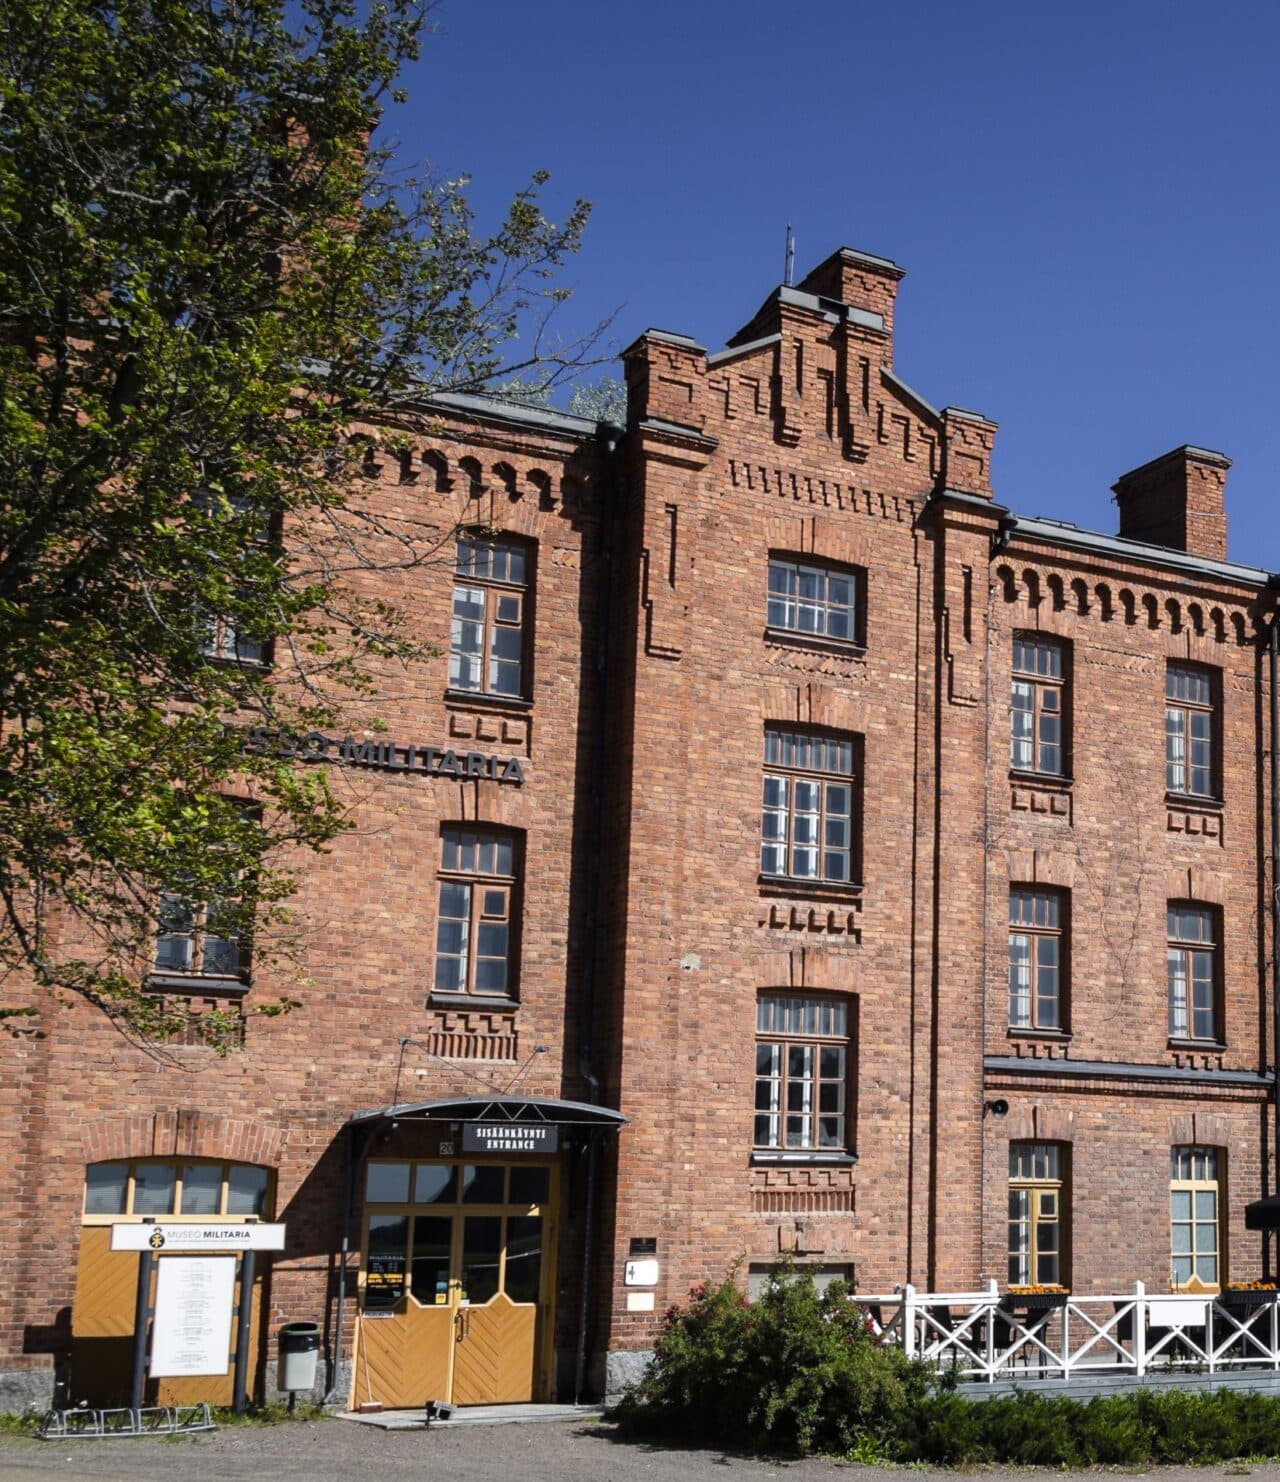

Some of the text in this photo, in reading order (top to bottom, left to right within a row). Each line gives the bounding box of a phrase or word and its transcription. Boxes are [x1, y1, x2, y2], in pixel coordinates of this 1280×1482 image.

[342, 737, 525, 782] MILITARIA
[477, 1127, 546, 1138] SISÄÄNKÄYNTI
[440, 1143, 454, 1153] 20
[487, 1140, 535, 1149] ENTRANCE
